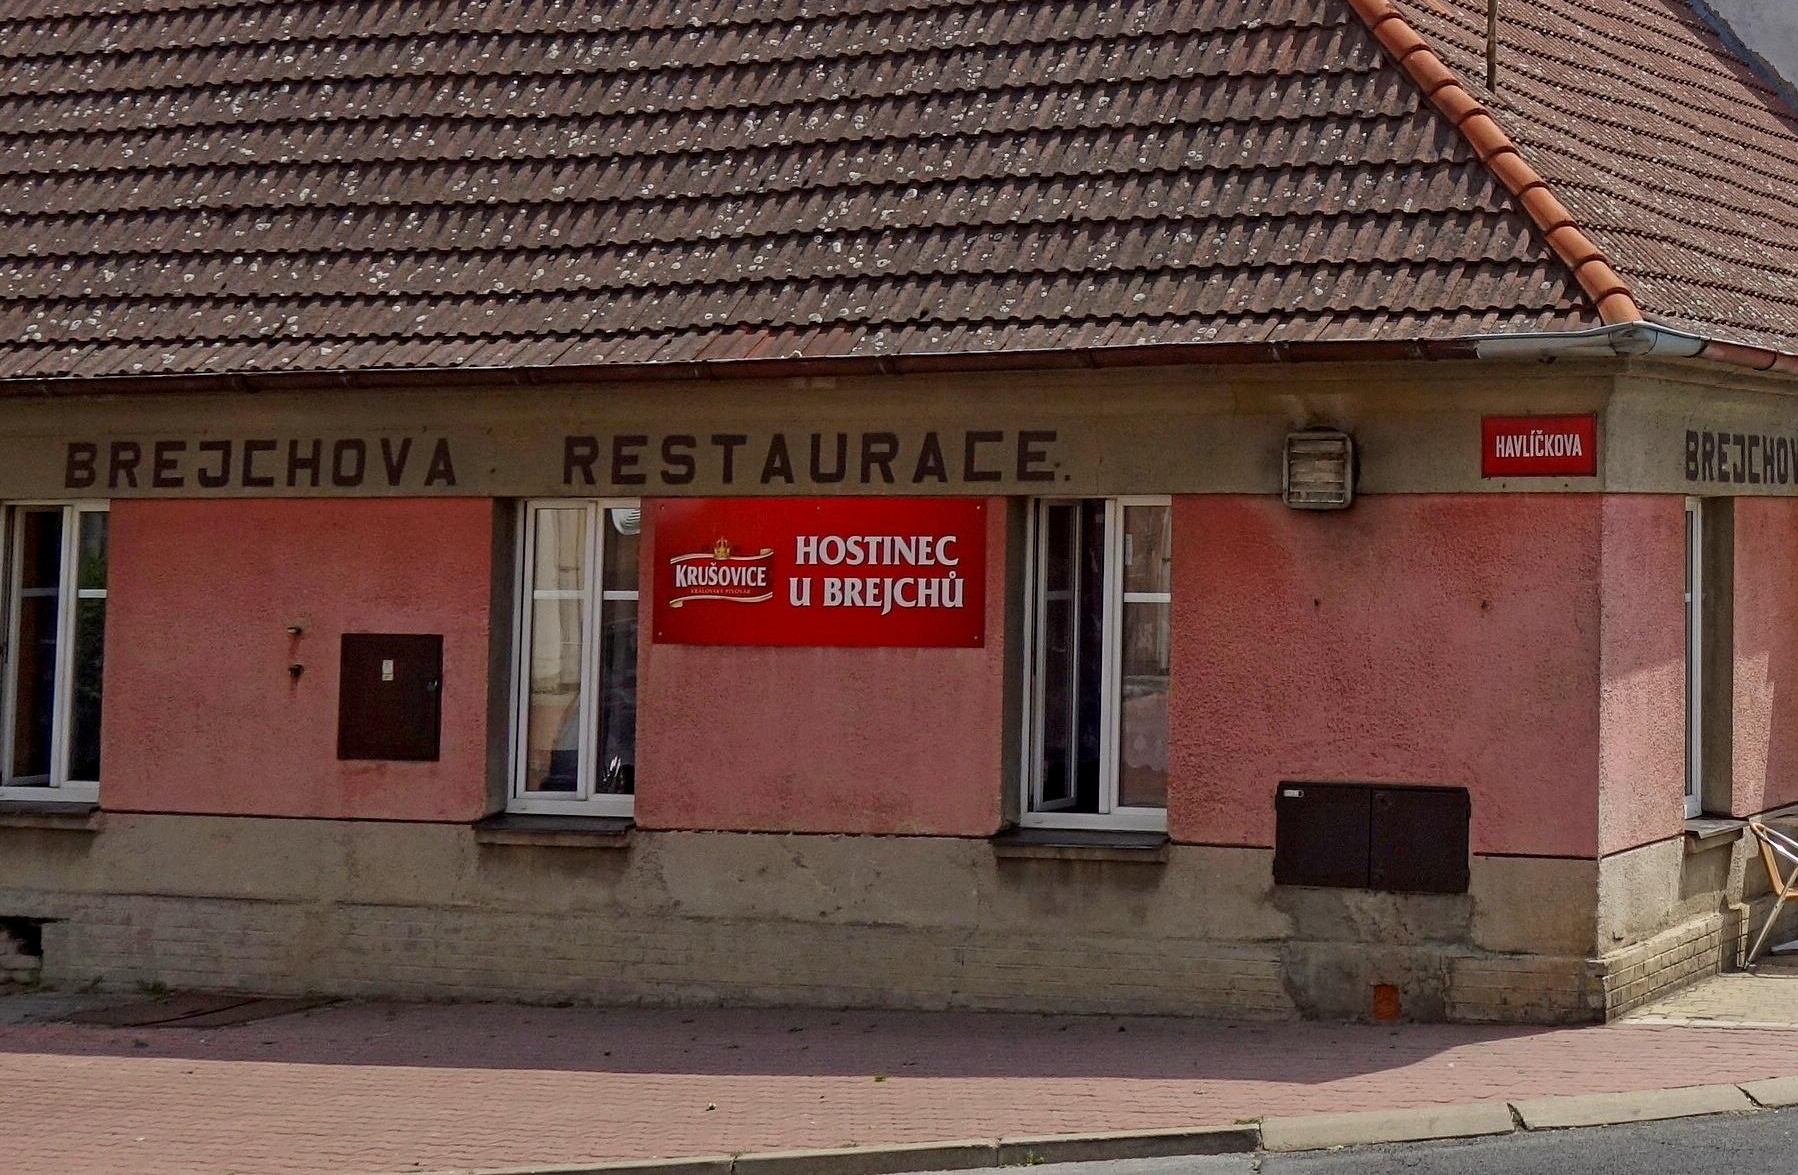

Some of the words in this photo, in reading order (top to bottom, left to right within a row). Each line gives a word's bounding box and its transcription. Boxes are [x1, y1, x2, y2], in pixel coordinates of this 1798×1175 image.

[1495, 429, 1583, 458] HAVLÍČKOVA
[64, 437, 458, 489] BREJCHOVA
[794, 535, 960, 567] HOSTINEC
[675, 561, 767, 588] KRUŠOVICE
[789, 577, 811, 607] U
[823, 571, 965, 616] BREJCHŮ
